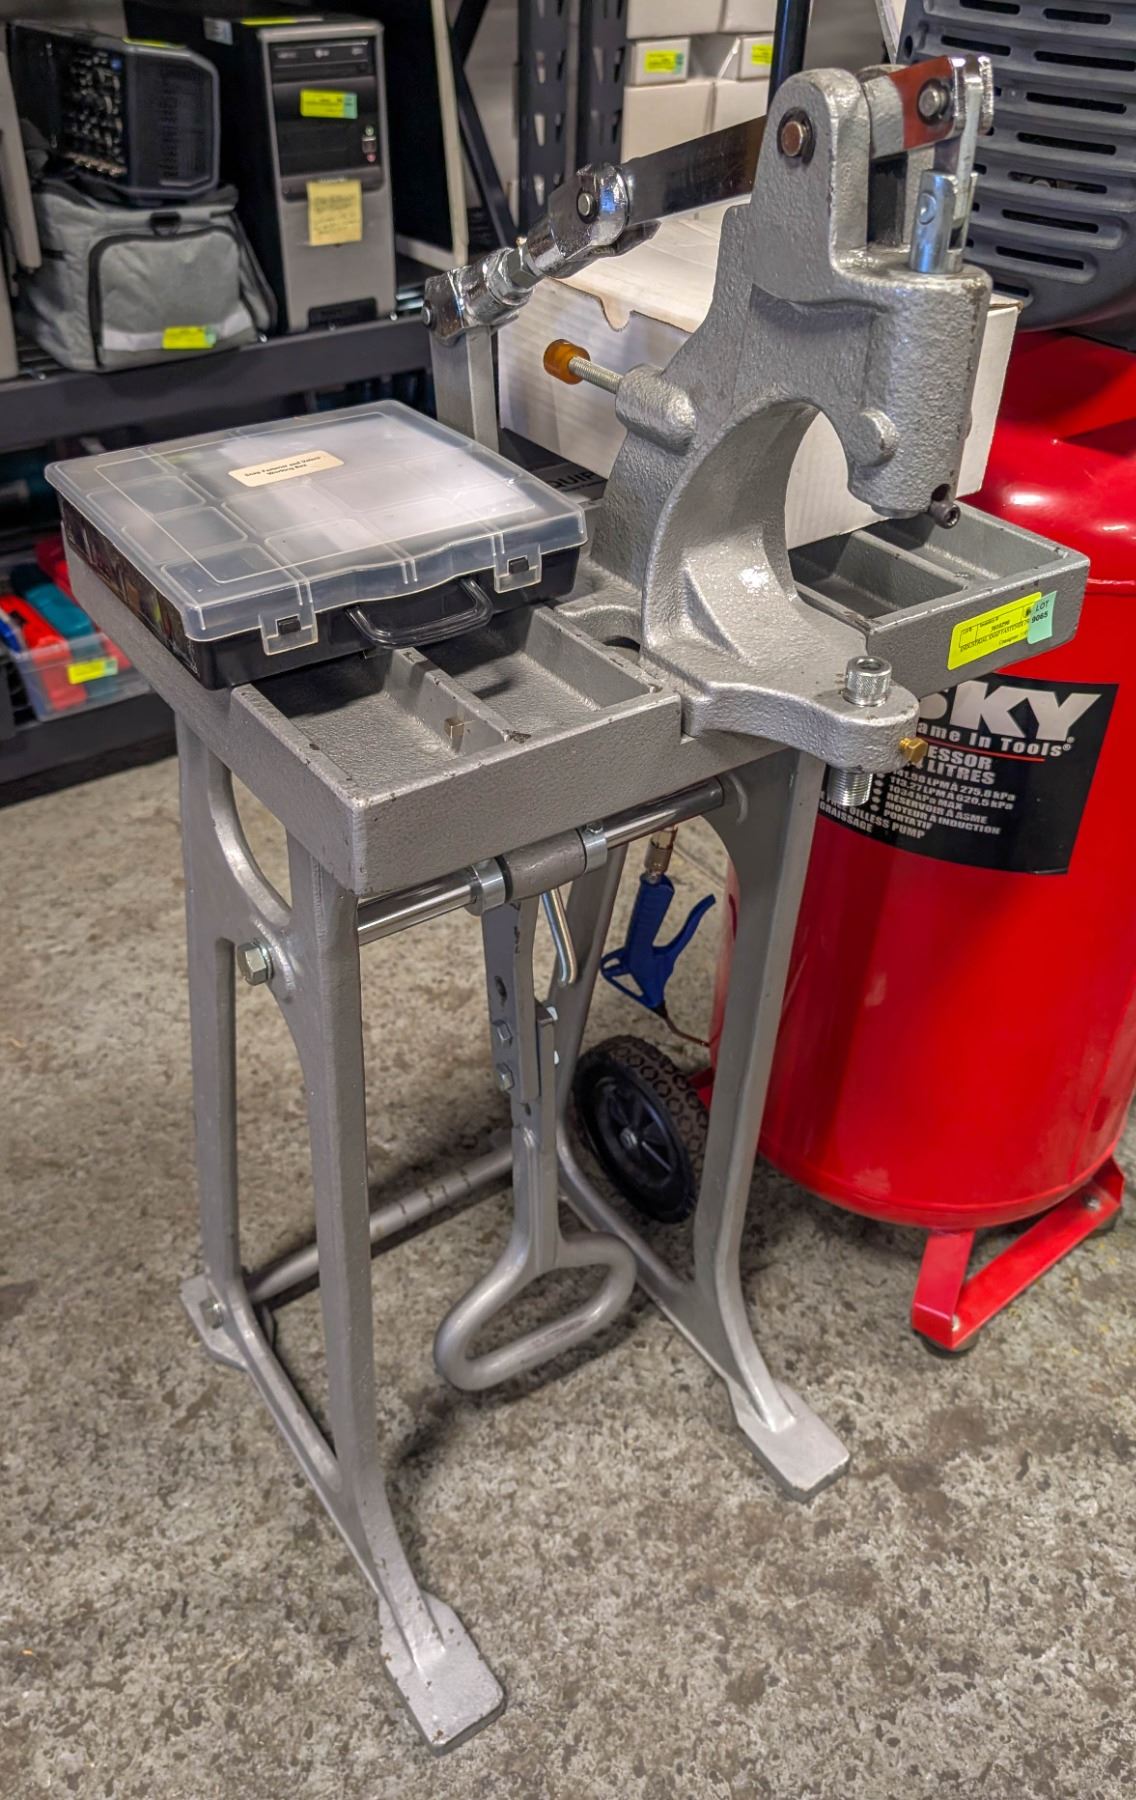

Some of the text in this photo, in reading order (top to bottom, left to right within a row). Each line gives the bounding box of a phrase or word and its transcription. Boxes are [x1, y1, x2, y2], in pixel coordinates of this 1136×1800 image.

[1036, 600, 1049, 611] LOT
[1031, 611, 1048, 623] 9065
[916, 722, 961, 743] ame
[927, 745, 993, 770] ESSOR
[927, 759, 996, 785] LITRES
[937, 799, 963, 811] MAX
[883, 809, 933, 830] PORTATIF
[884, 801, 928, 820] MOTEUR
[938, 816, 1001, 834] INDUCTION
[955, 812, 988, 824] ASME
[891, 822, 925, 839] PUMP
